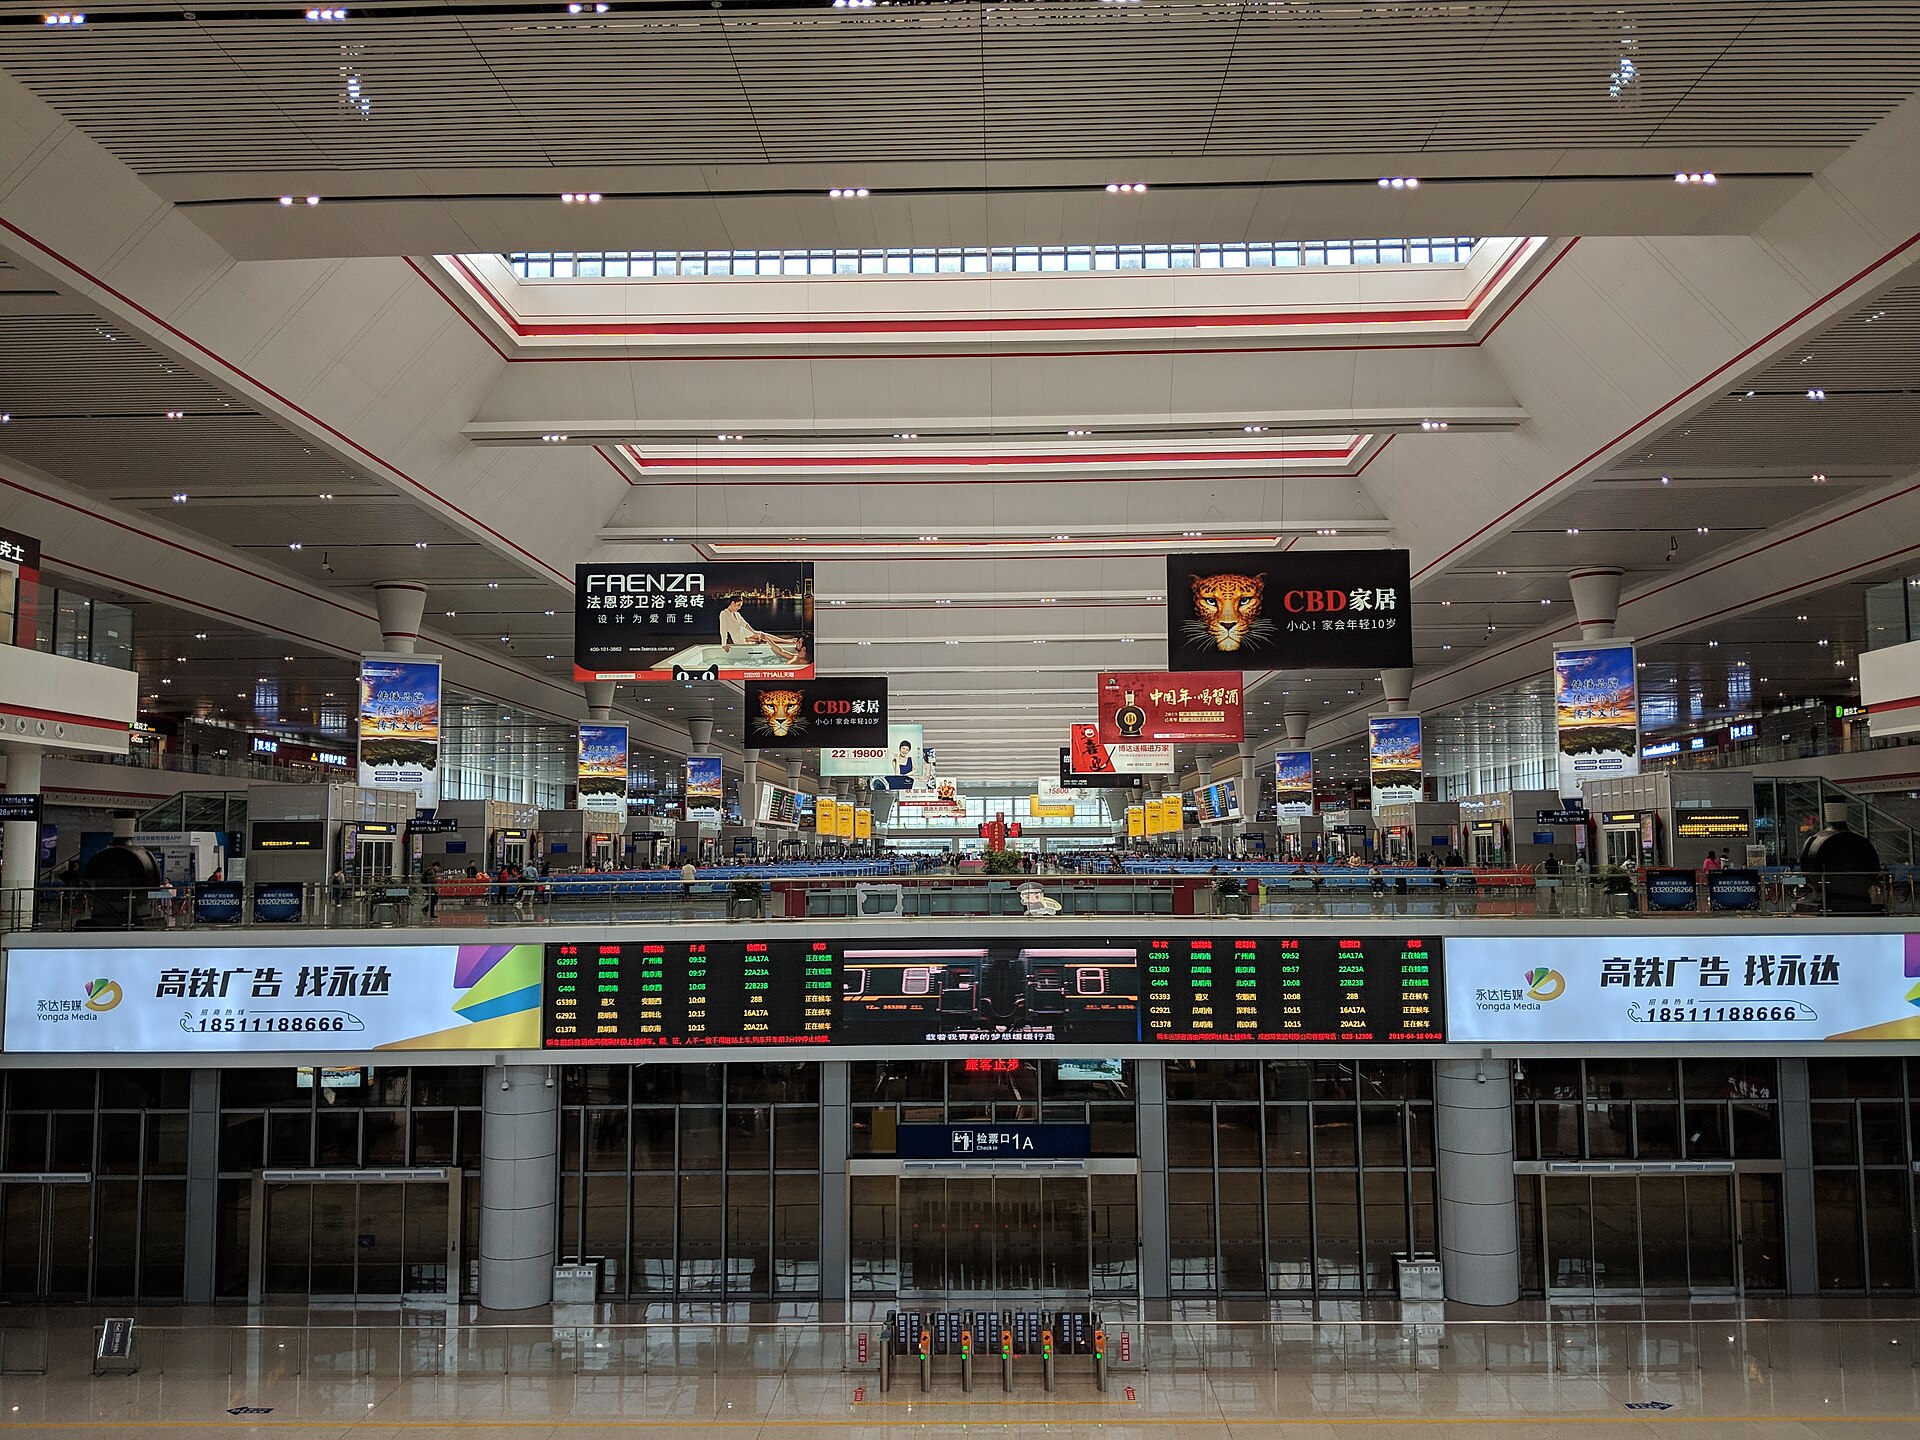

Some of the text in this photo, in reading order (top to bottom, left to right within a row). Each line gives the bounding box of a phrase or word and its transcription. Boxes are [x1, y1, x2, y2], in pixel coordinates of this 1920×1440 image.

[586, 573, 705, 593] FAENZA
[587, 595, 705, 609] 法恩莎卫浴·瓷砖
[1284, 588, 1397, 613] CBD家居
[598, 614, 693, 624] 设计为爱而生
[813, 700, 880, 714] CBD家居
[831, 749, 883, 758] 22 19800
[1600, 955, 1840, 987] 高铁广告 找永达
[156, 965, 392, 998] 高铁广告 找永达
[1475, 989, 1523, 1001] 永达传媒
[37, 999, 82, 1012] 永达传媒
[1476, 1001, 1541, 1012] Yongda Media
[37, 1012, 97, 1023] Yongda Media
[1647, 1006, 1796, 1022] 18511188666
[198, 1016, 344, 1032] 18511188666
[965, 1058, 1019, 1071] 旅客止步
[977, 1133, 1010, 1144] 检票口
